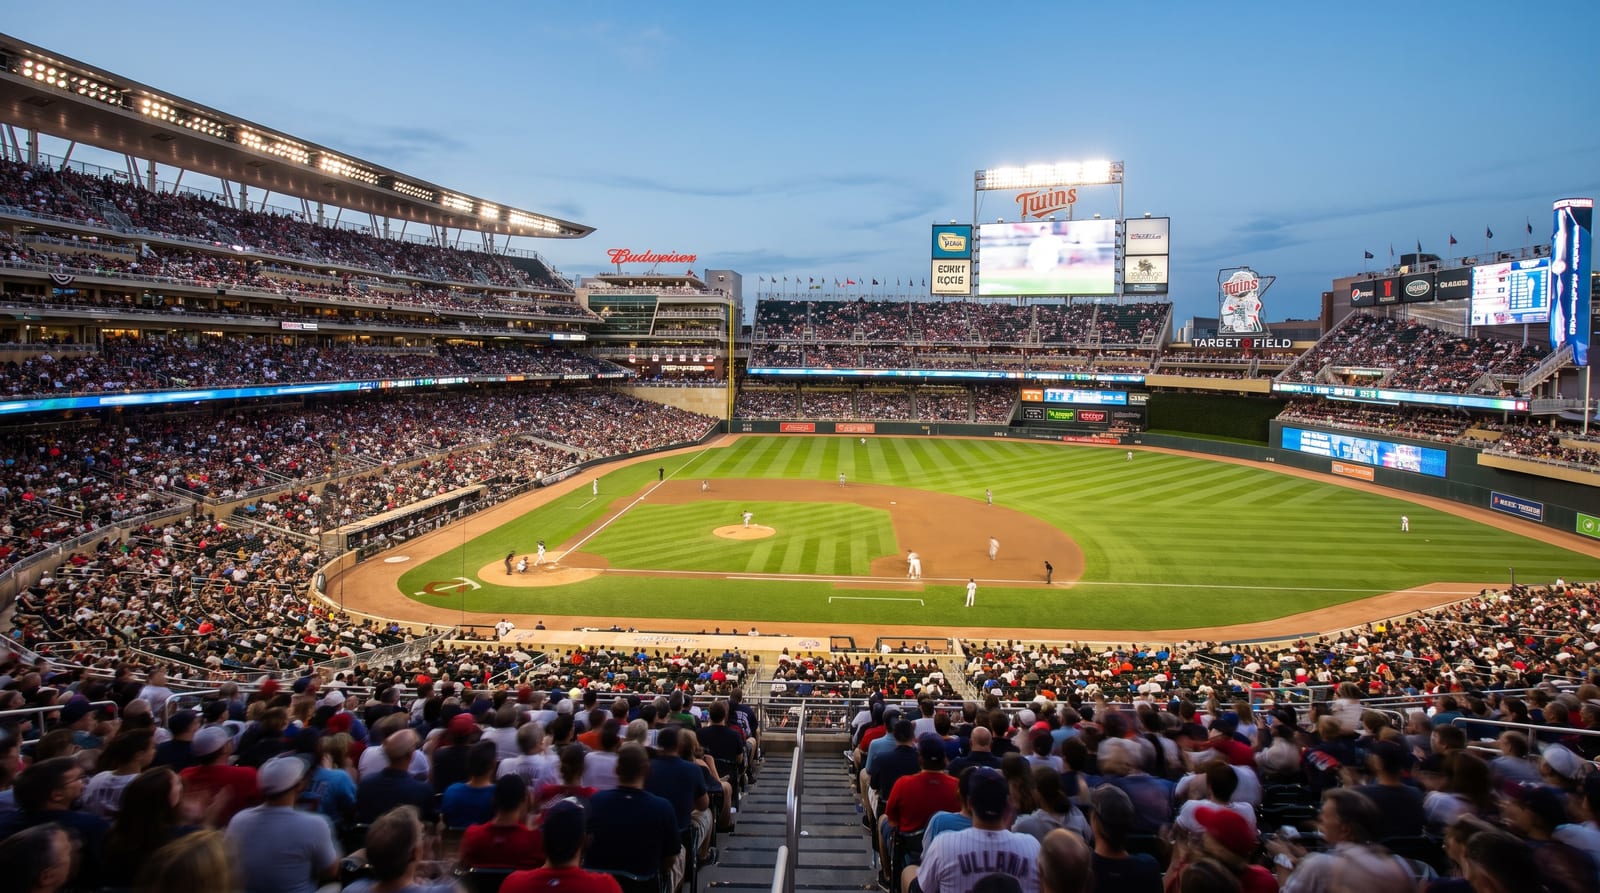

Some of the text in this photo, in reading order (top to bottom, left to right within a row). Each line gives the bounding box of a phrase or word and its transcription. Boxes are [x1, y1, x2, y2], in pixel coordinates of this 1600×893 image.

[1015, 188, 1077, 217] Twins
[607, 249, 697, 264] Budweiser
[1223, 279, 1259, 297] Twins
[1193, 338, 1292, 348] TARGET FIELD
